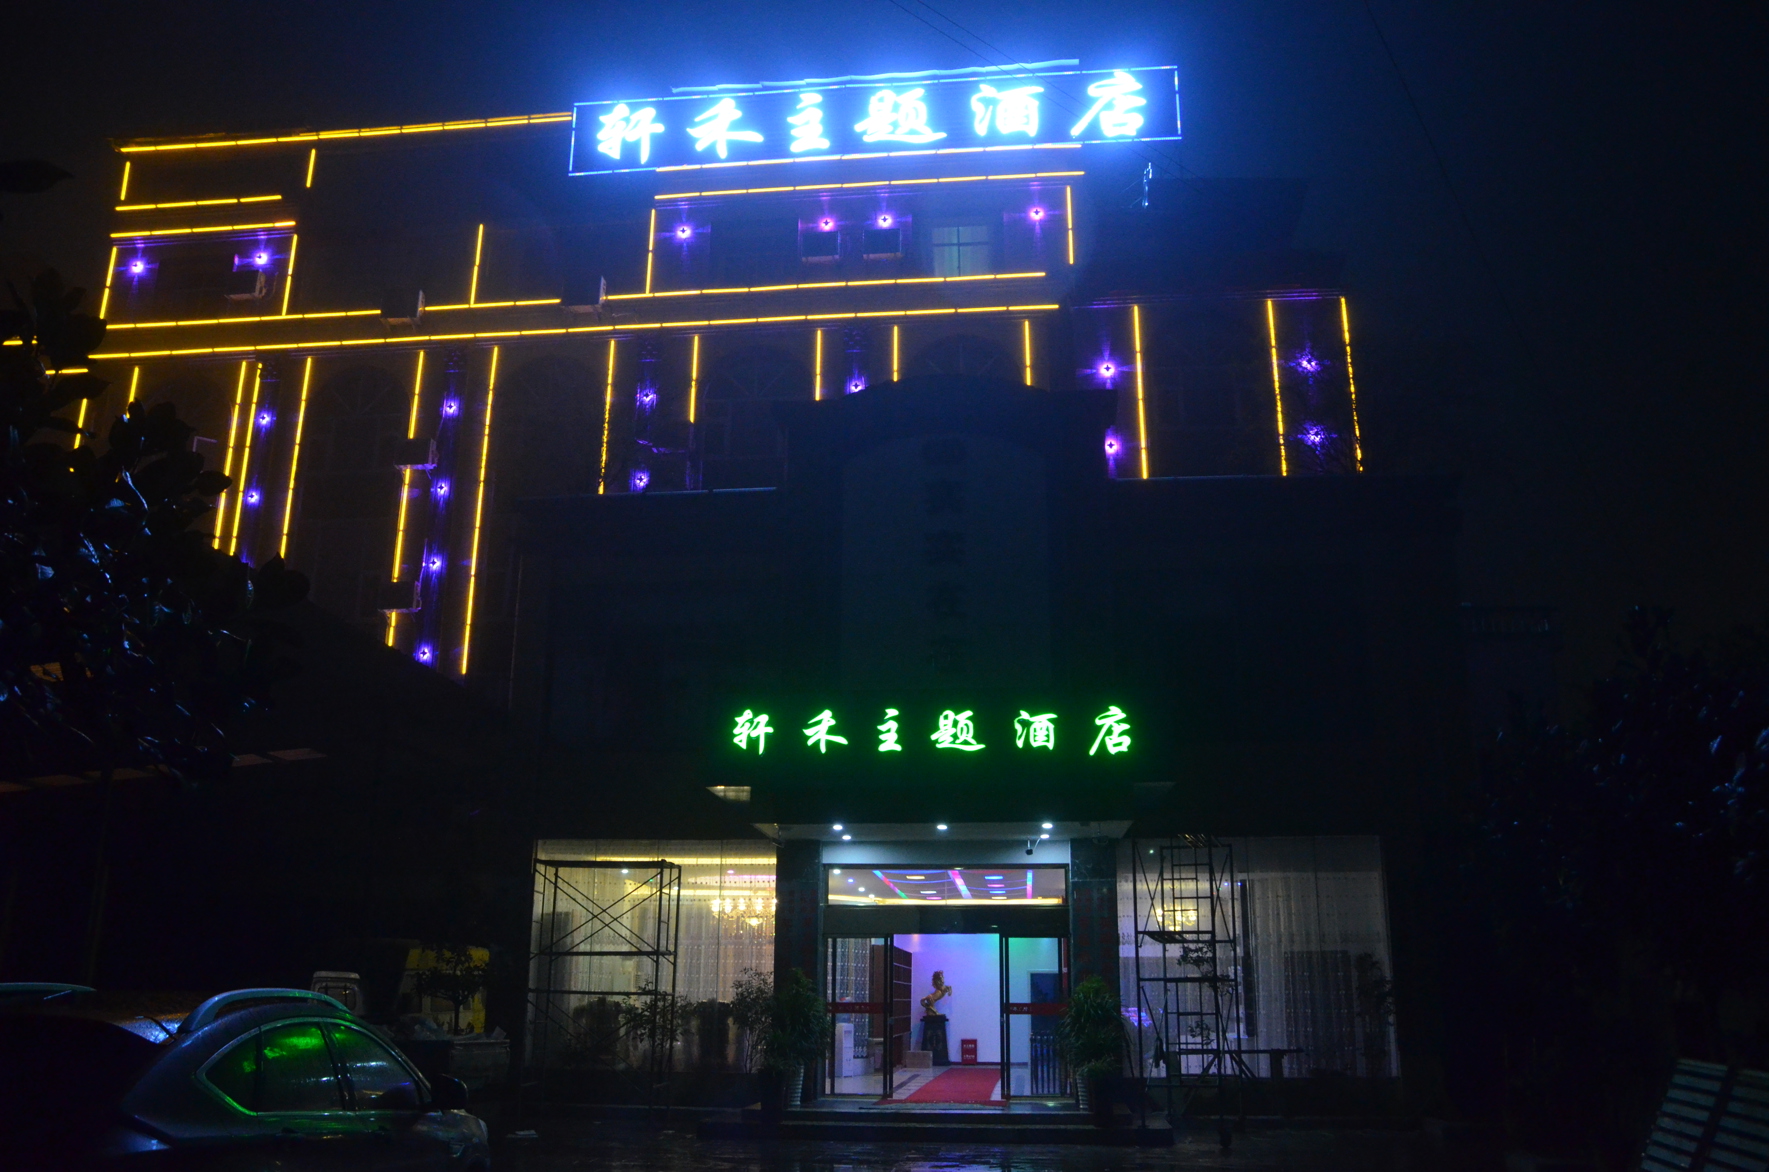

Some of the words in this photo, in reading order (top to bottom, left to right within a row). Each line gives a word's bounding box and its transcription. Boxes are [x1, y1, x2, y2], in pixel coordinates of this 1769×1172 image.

[596, 71, 1146, 164] 轩禾主题酒店
[732, 705, 1132, 757] 轩禾主题酒店
